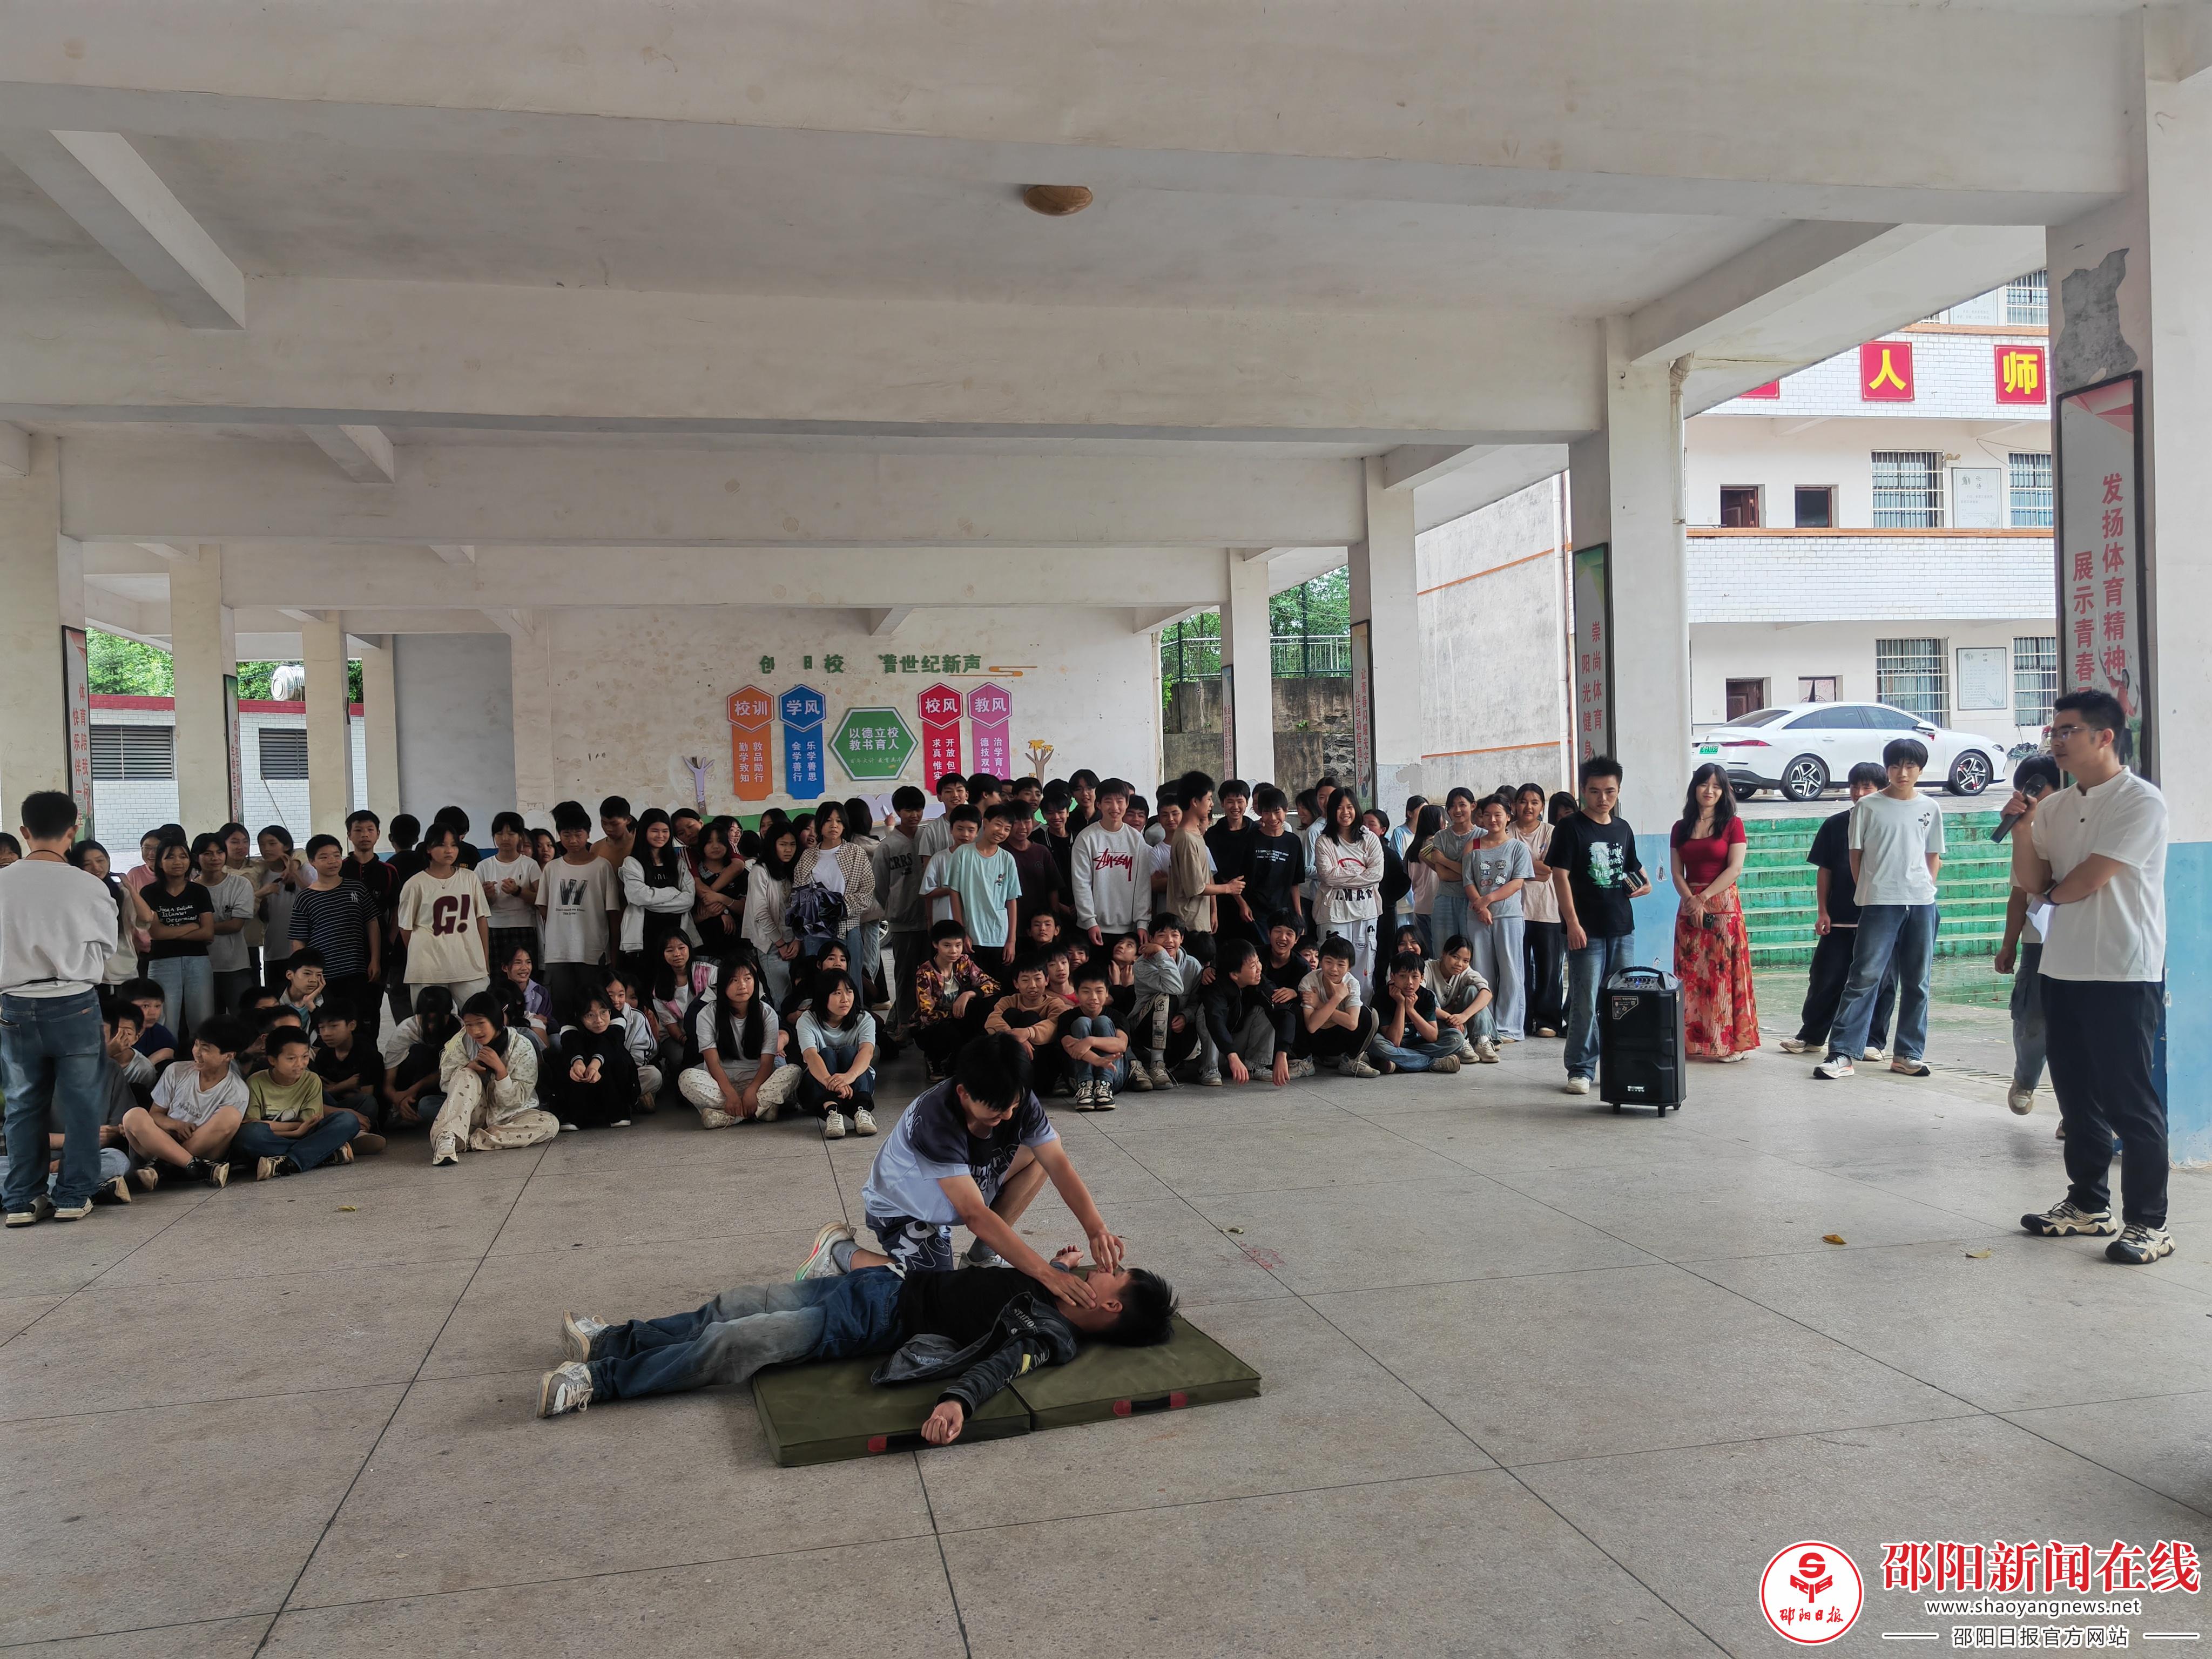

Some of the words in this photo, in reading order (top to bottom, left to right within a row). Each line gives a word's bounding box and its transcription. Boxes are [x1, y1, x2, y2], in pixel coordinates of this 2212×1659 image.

[1869, 349, 1906, 390] 人
[2002, 351, 2038, 394] 师
[2101, 473, 2126, 676] 发扬体育精神
[2073, 550, 2096, 692] 展示青春
[1591, 621, 1602, 730] 崇尚体育
[734, 700, 767, 716] 校训
[786, 700, 820, 716] 学风
[925, 698, 957, 713] 校风
[975, 698, 1007, 712] 教风
[849, 727, 899, 739] 以德立校
[849, 739, 899, 751] 教书育人
[739, 742, 750, 783] 勤学致知
[753, 741, 764, 782] 敦品励行
[792, 741, 802, 781] 会学善行
[807, 741, 817, 781] 乐学善思
[994, 737, 1003, 777] 治学育人
[560, 879, 588, 905] W
[1593, 868, 1608, 877] THE
[432, 894, 470, 936] G!
